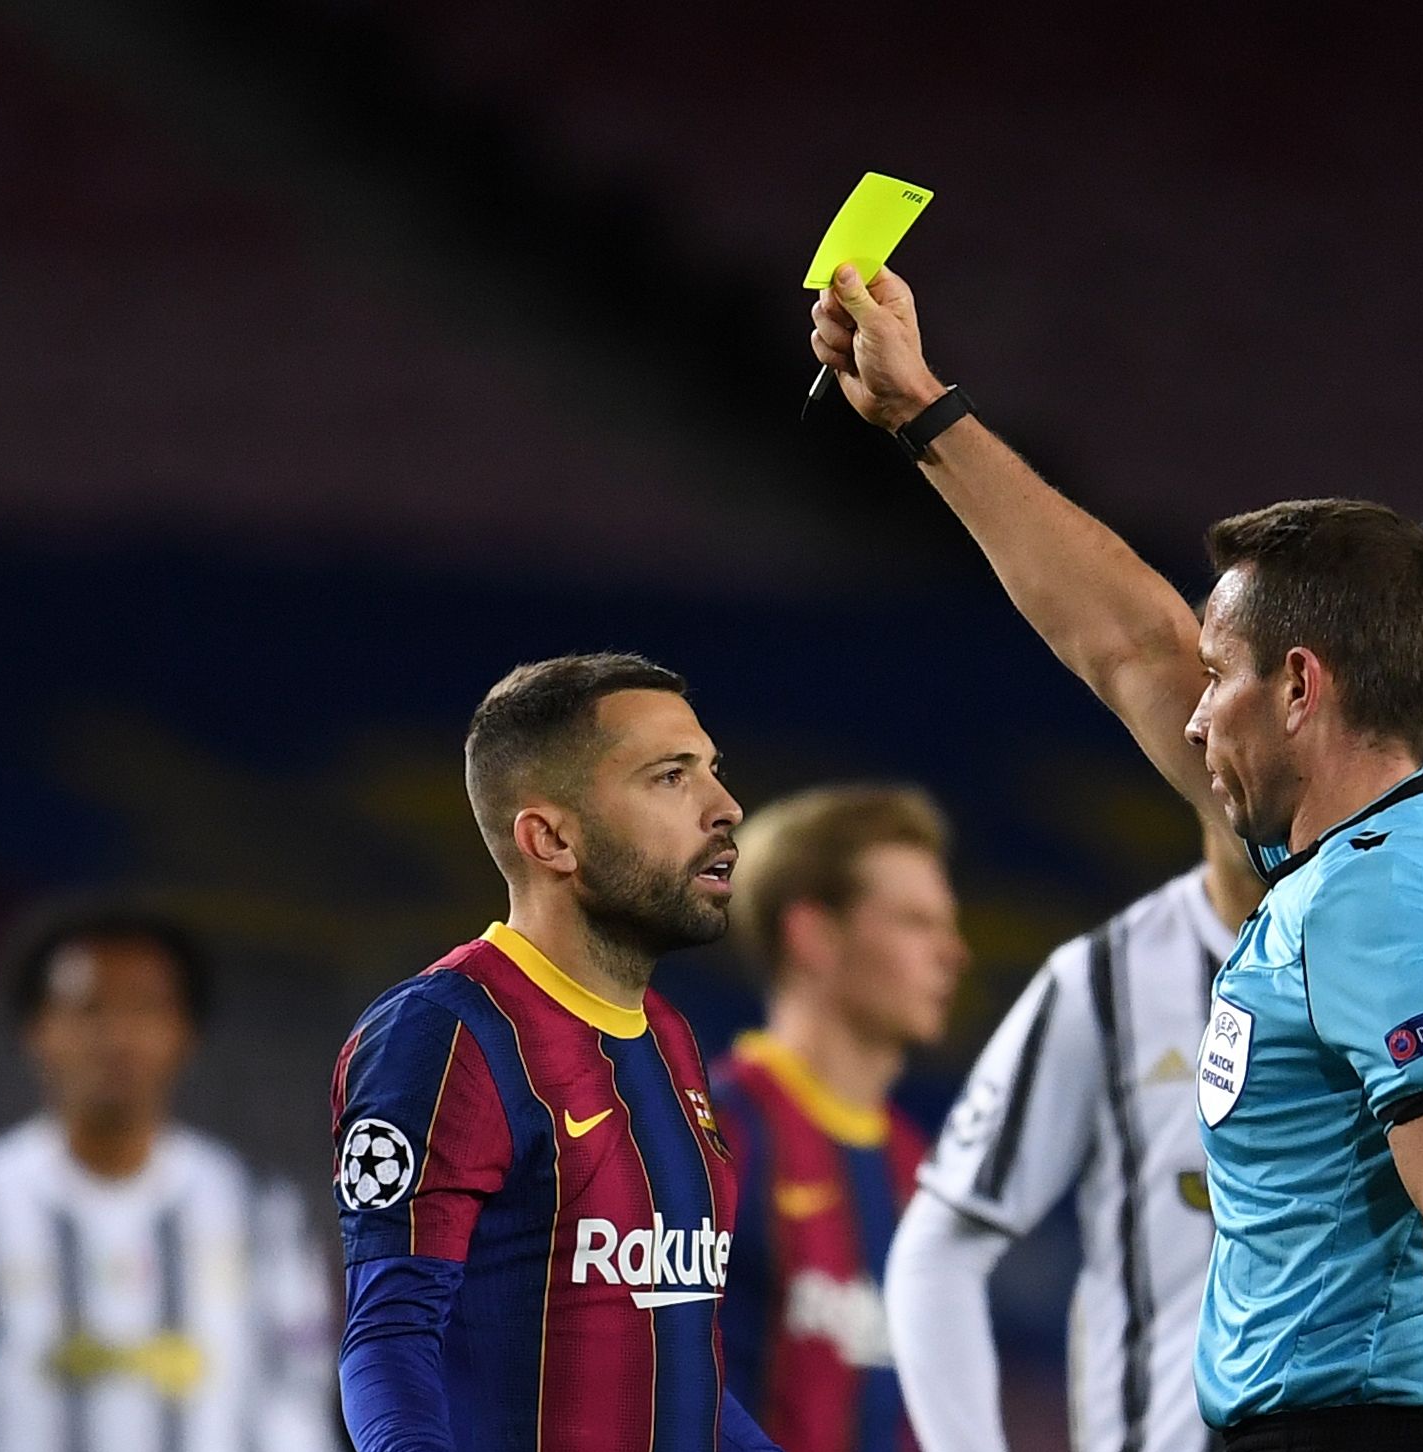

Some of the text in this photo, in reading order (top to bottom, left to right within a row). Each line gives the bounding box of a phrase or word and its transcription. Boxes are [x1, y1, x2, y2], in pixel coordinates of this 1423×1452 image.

[902, 190, 925, 204] FIFA
[1208, 1051, 1234, 1074] MATCH
[1201, 1068, 1235, 1094] OFFICIAL
[571, 1212, 733, 1288] Rakute
